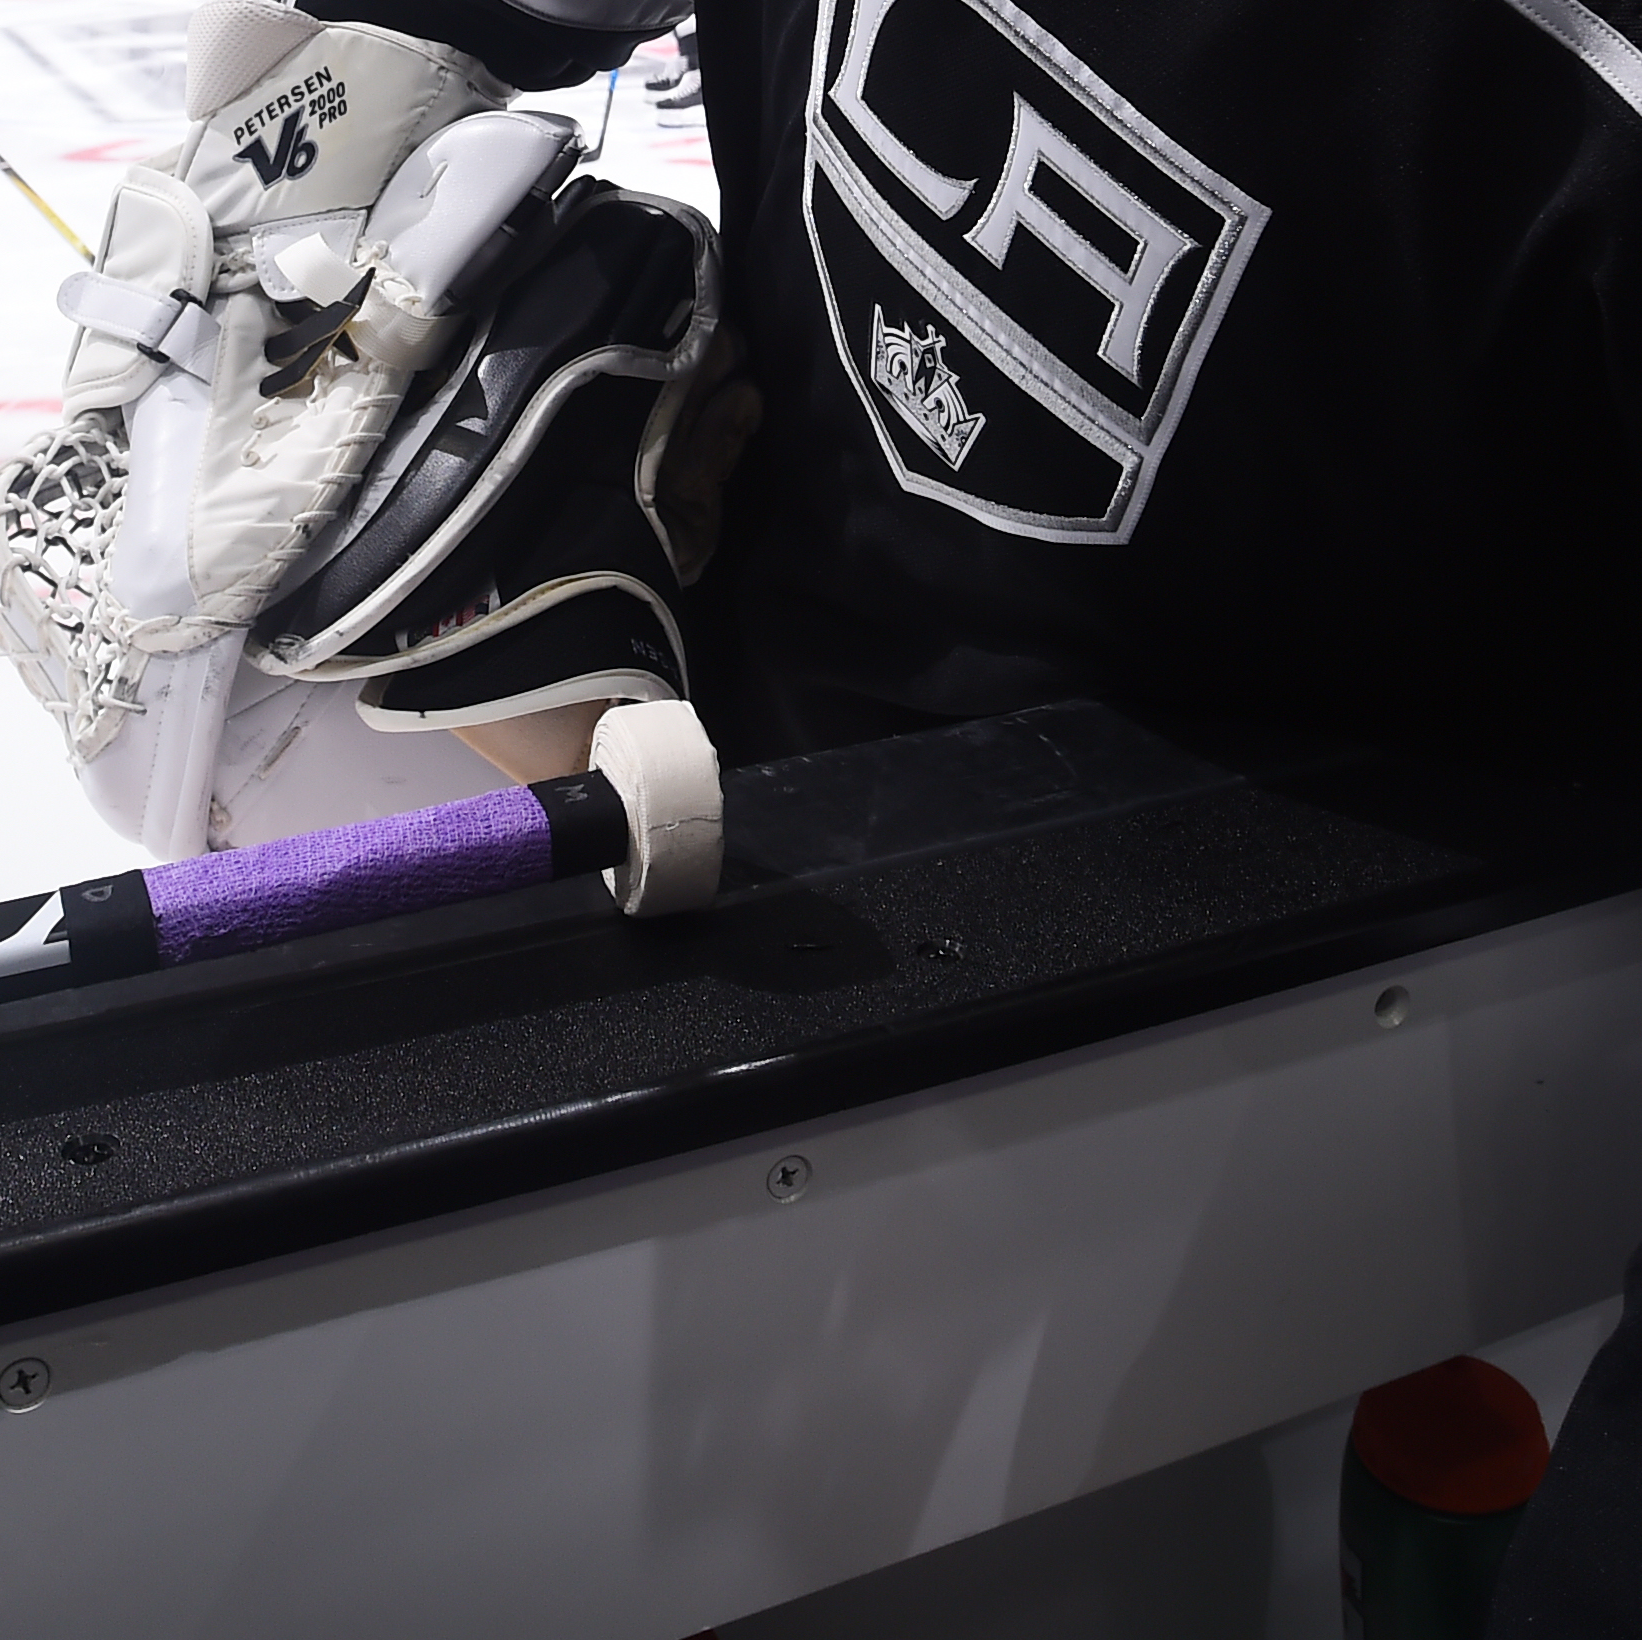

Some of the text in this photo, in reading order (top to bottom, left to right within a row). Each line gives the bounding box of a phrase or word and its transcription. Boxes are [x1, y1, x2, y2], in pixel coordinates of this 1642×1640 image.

[233, 65, 333, 147] PETERSEN
[308, 81, 347, 118] 2000
[318, 98, 349, 130] PRO
